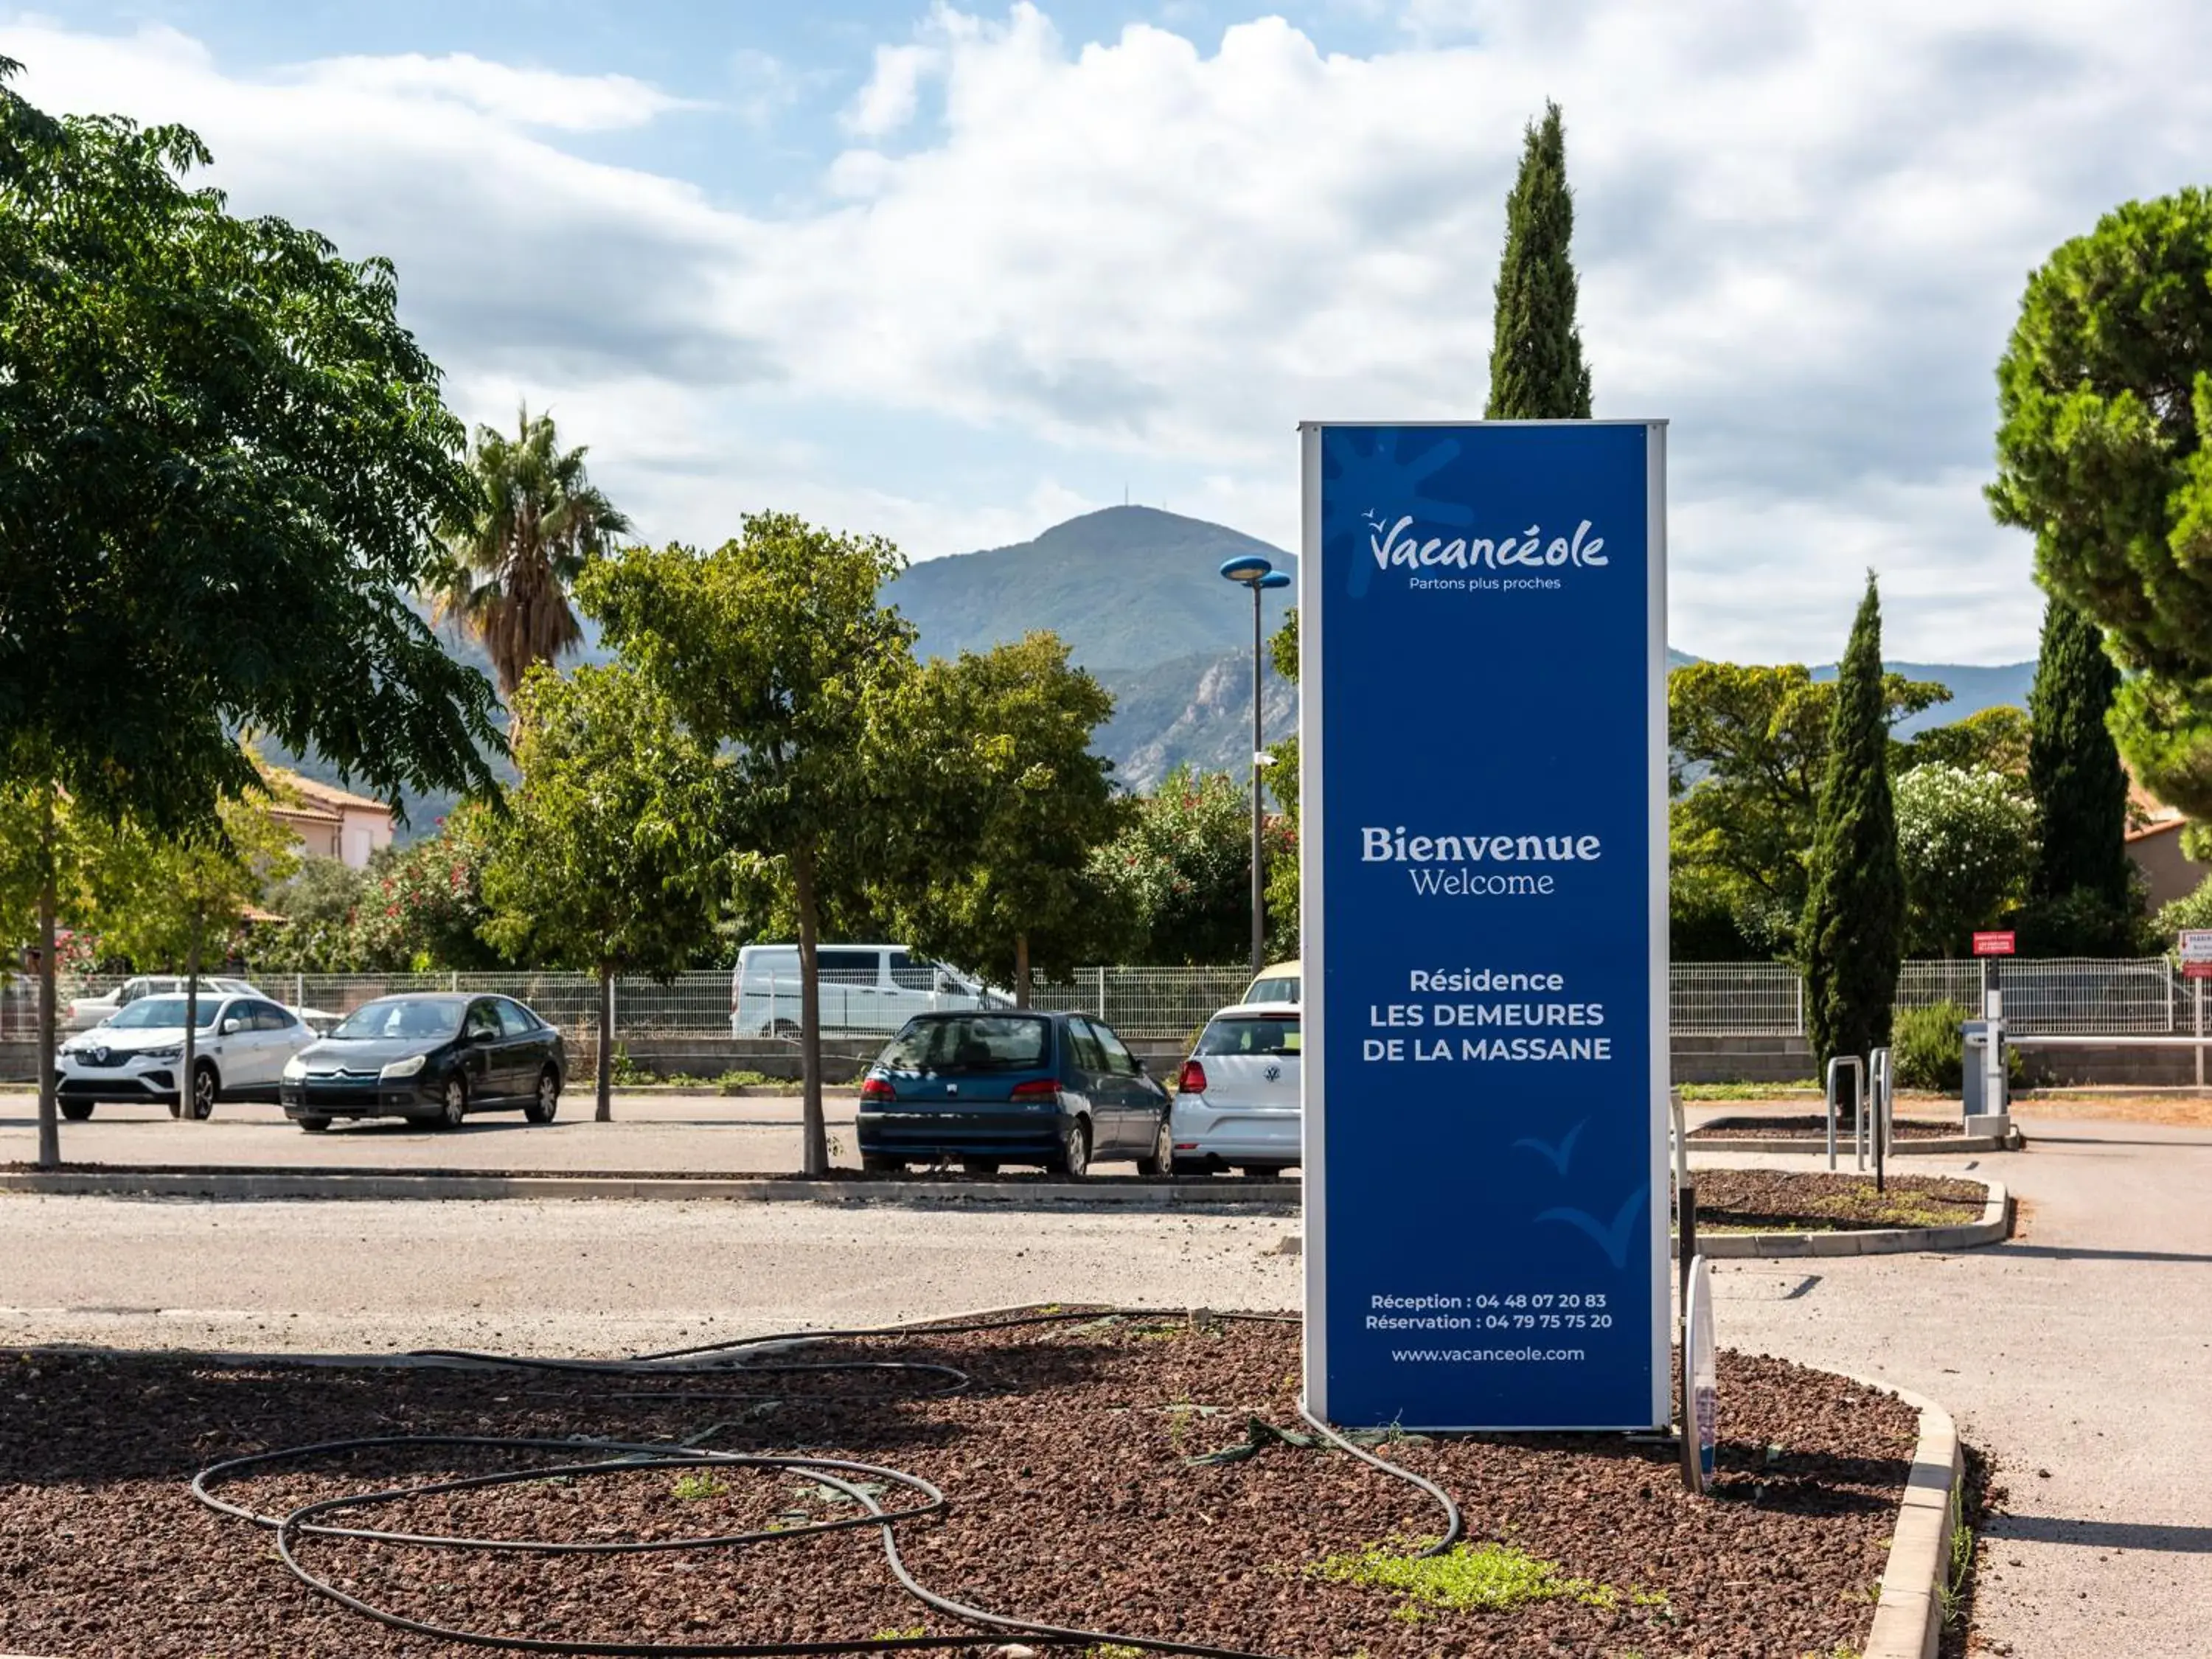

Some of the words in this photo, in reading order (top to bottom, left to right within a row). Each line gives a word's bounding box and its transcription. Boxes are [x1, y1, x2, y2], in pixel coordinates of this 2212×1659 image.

[1370, 515, 1610, 571] Vacancéole
[1410, 577, 1465, 590] Partons
[1470, 577, 1499, 592] plus
[1503, 577, 1561, 592] proches
[1361, 826, 1601, 862] Bienvenue
[1408, 868, 1554, 896] Welcome
[1411, 967, 1564, 992] Résidence
[1371, 1004, 1424, 1027] LES
[1434, 1004, 1604, 1026] DEMEURES
[1363, 1039, 1405, 1061] DE
[1415, 1039, 1453, 1061] LA
[1462, 1037, 1611, 1061] MASSANE
[1371, 1293, 1461, 1312] Réception
[1475, 1295, 1500, 1308] 04
[1504, 1294, 1527, 1308] 48
[1531, 1294, 1554, 1308] 07
[1559, 1294, 1580, 1308] 20
[1585, 1294, 1606, 1308] 83
[1366, 1314, 1471, 1329] Réservation
[1486, 1315, 1509, 1329] 04
[1513, 1315, 1534, 1329] 79
[1540, 1315, 1561, 1329] 75
[1565, 1315, 1586, 1329] 75
[1590, 1315, 1613, 1329] 20
[1391, 1346, 1585, 1362] www.vacanceole.com
